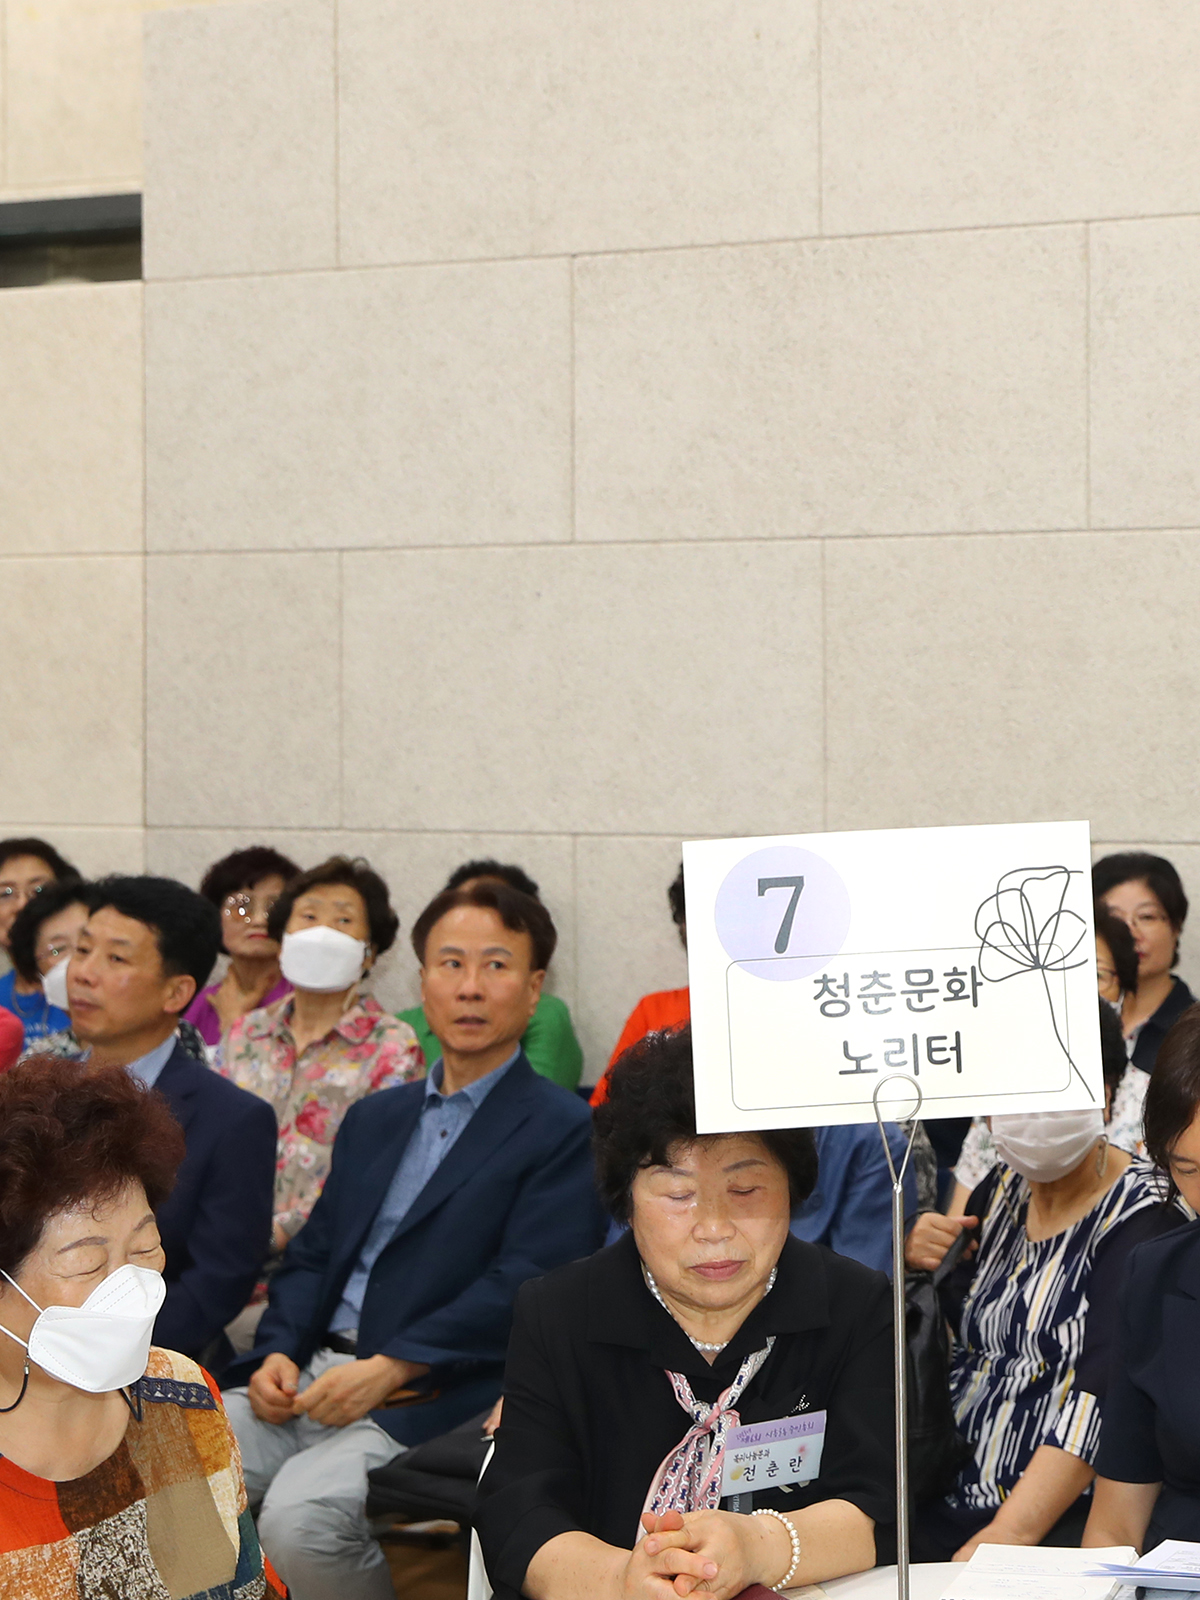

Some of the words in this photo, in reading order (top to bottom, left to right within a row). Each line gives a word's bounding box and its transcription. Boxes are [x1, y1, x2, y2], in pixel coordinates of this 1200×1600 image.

[757, 875, 804, 954] 7
[813, 965, 983, 1018] 청춘문화
[839, 1031, 963, 1076] 노리터
